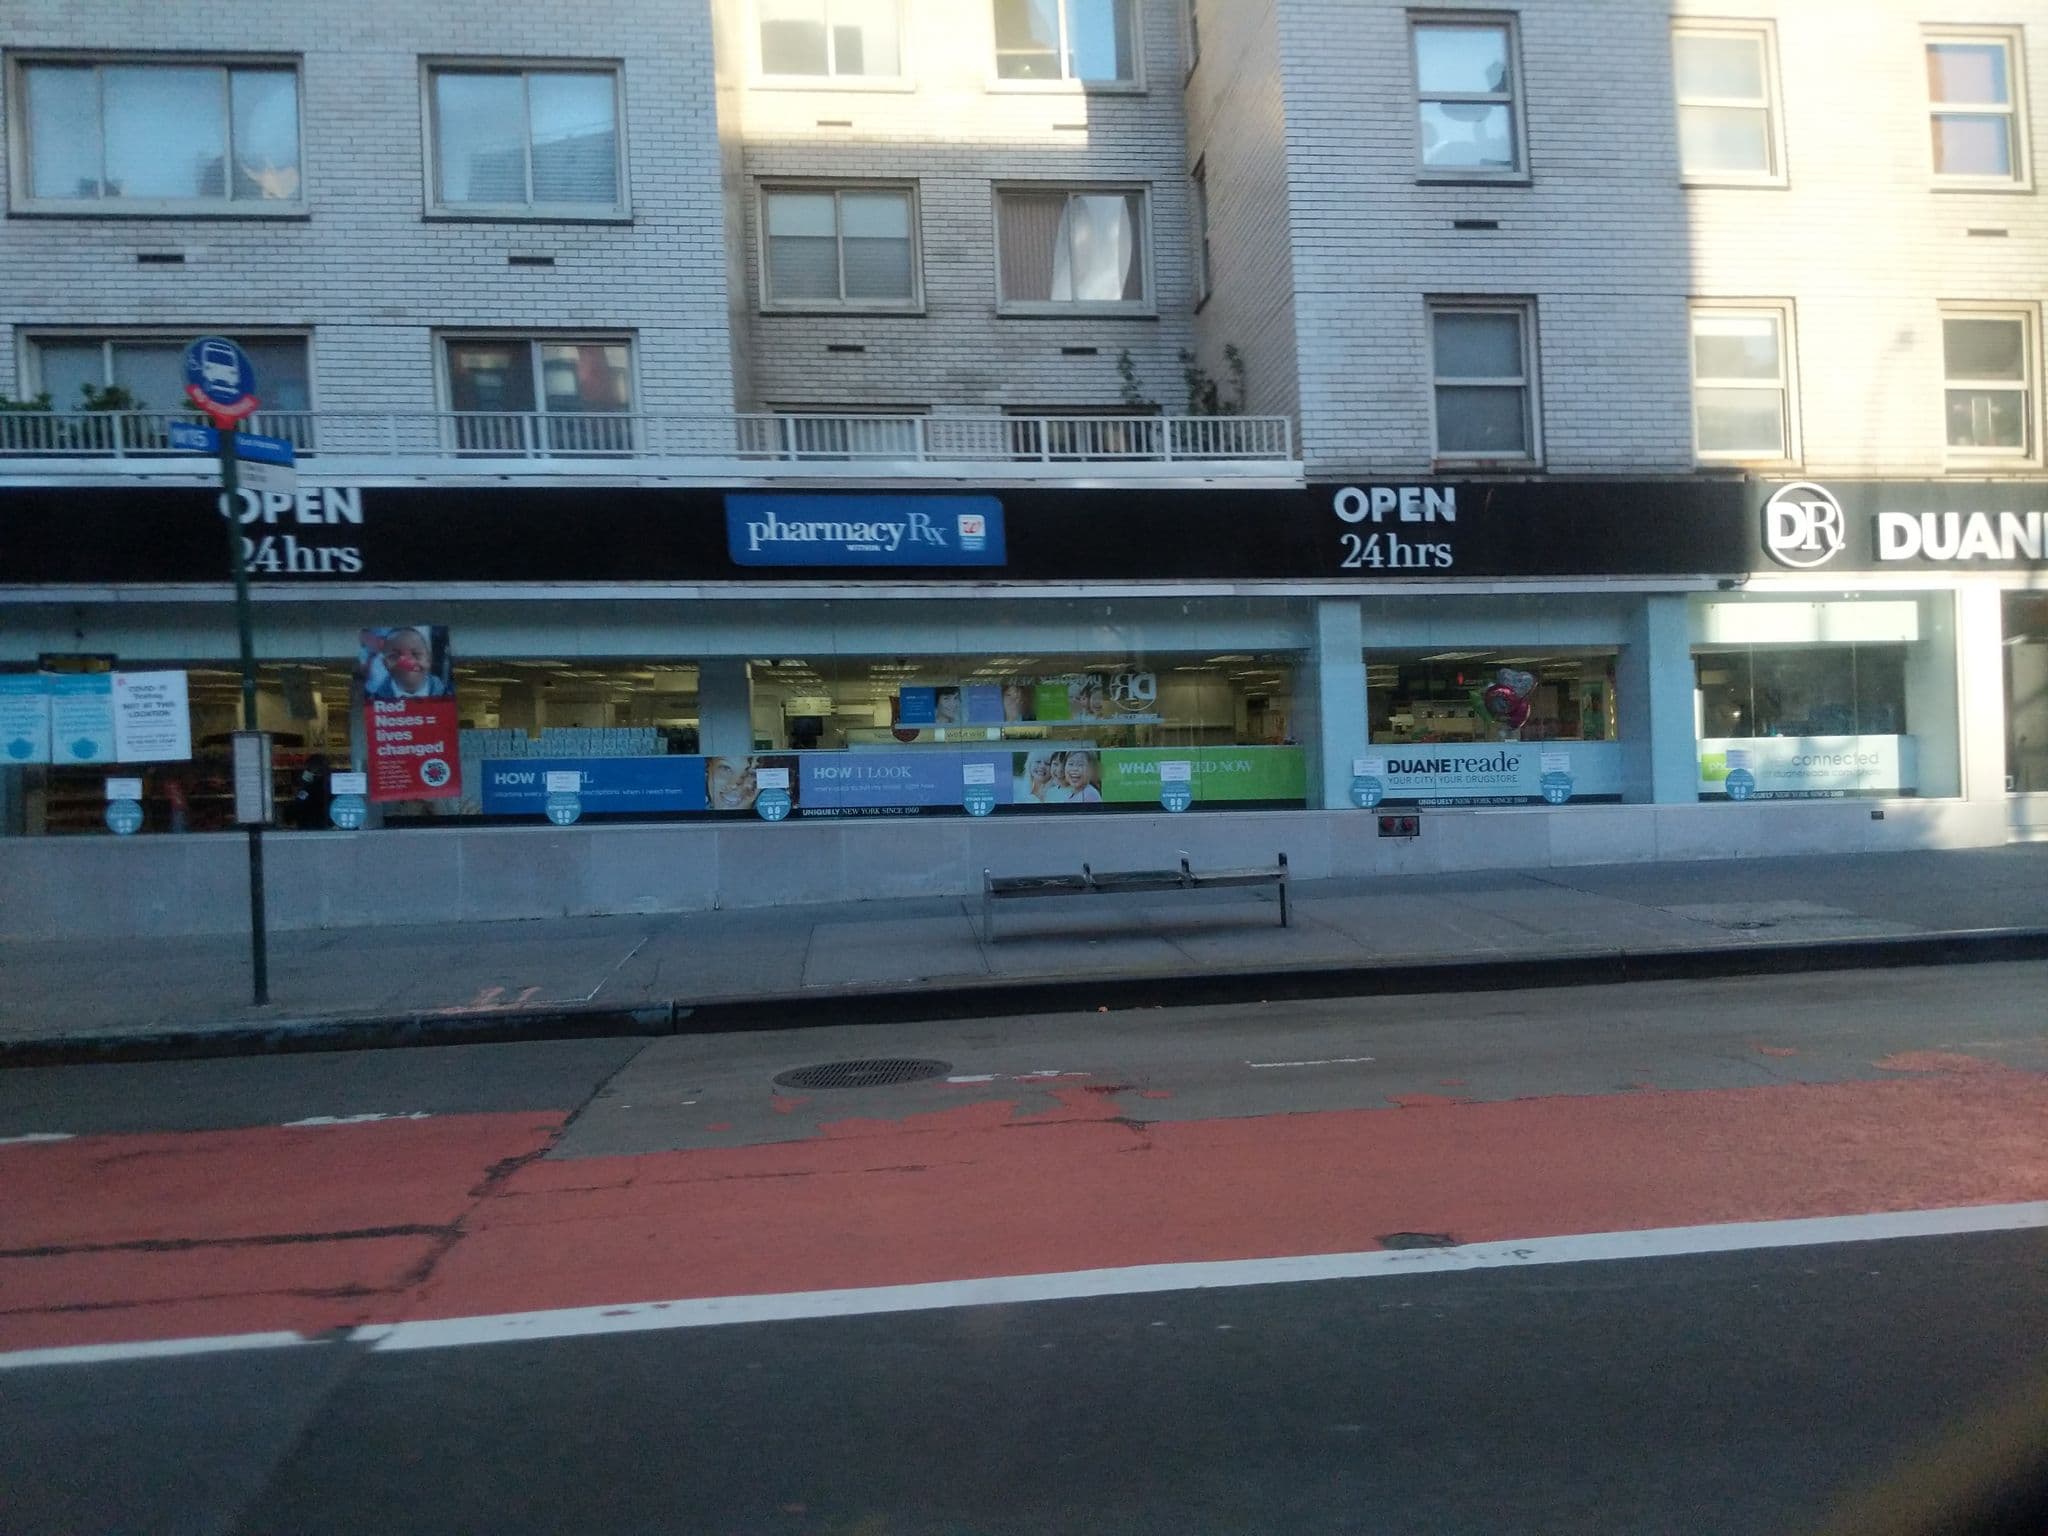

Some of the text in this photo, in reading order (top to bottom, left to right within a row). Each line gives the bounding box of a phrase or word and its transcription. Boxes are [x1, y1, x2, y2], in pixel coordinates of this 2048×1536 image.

[219, 487, 364, 524] OPEN
[1334, 487, 1457, 523] OPEN
[747, 511, 905, 551] pharmacy
[1878, 511, 2048, 560] DUAN
[1340, 533, 1454, 568] 24hrs
[374, 700, 406, 712] Red
[375, 715, 424, 727] Noses
[376, 730, 413, 741] lives
[377, 741, 444, 756] changed
[1387, 751, 1519, 774] DUANE reade
[1791, 750, 1880, 767] connected
[494, 772, 535, 785] HOW
[814, 767, 851, 779] HOW
[868, 765, 913, 779] LOOK
[1388, 776, 1413, 785] YOUR
[1439, 775, 1463, 784] YOUR
[1466, 774, 1518, 784] DRUGSTORE
[802, 807, 840, 816] UNIQUELY
[842, 807, 859, 815] NEW
[860, 807, 880, 815] YORK
[882, 807, 902, 815] SINCE
